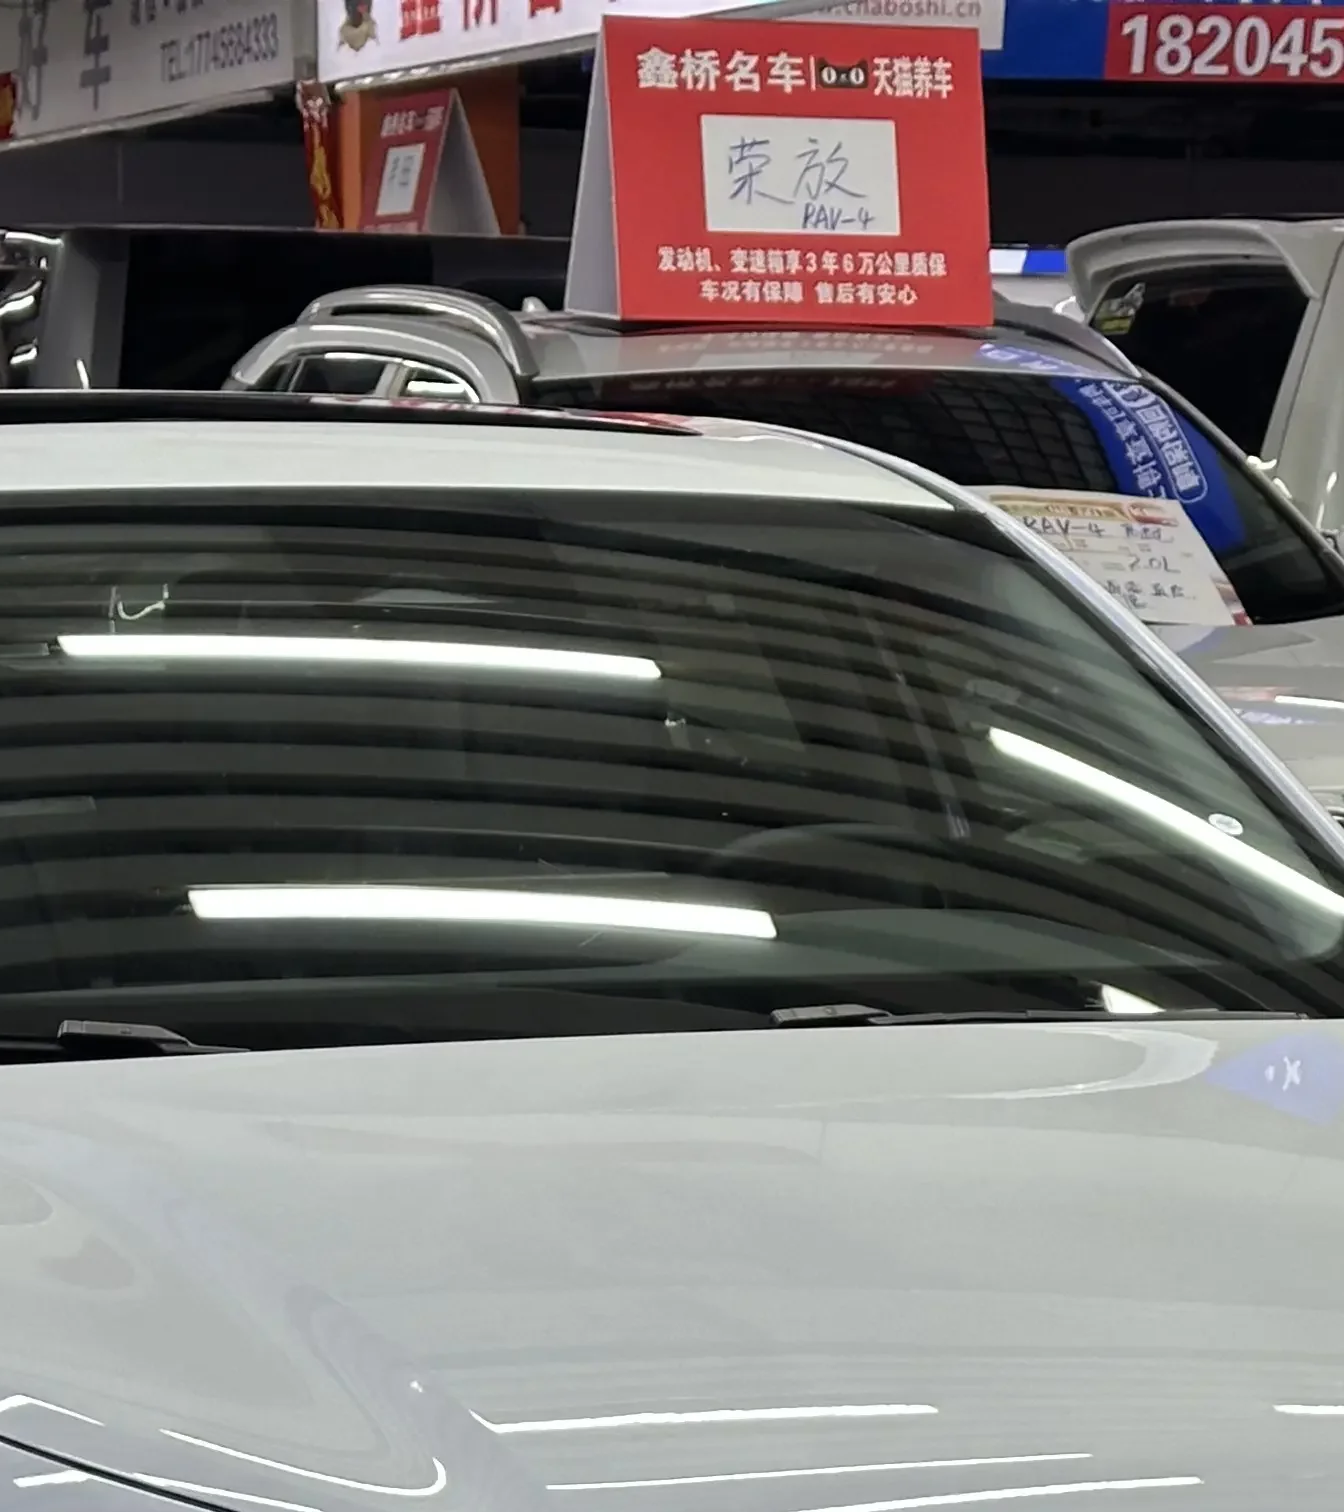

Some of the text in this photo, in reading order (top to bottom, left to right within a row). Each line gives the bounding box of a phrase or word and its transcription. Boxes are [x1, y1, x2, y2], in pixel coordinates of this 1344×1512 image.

[637, 46, 953, 98] 鑫桥名车 天猫养车
[728, 136, 868, 204] 荣放
[700, 279, 918, 305] 车况有保障 售后有安心
